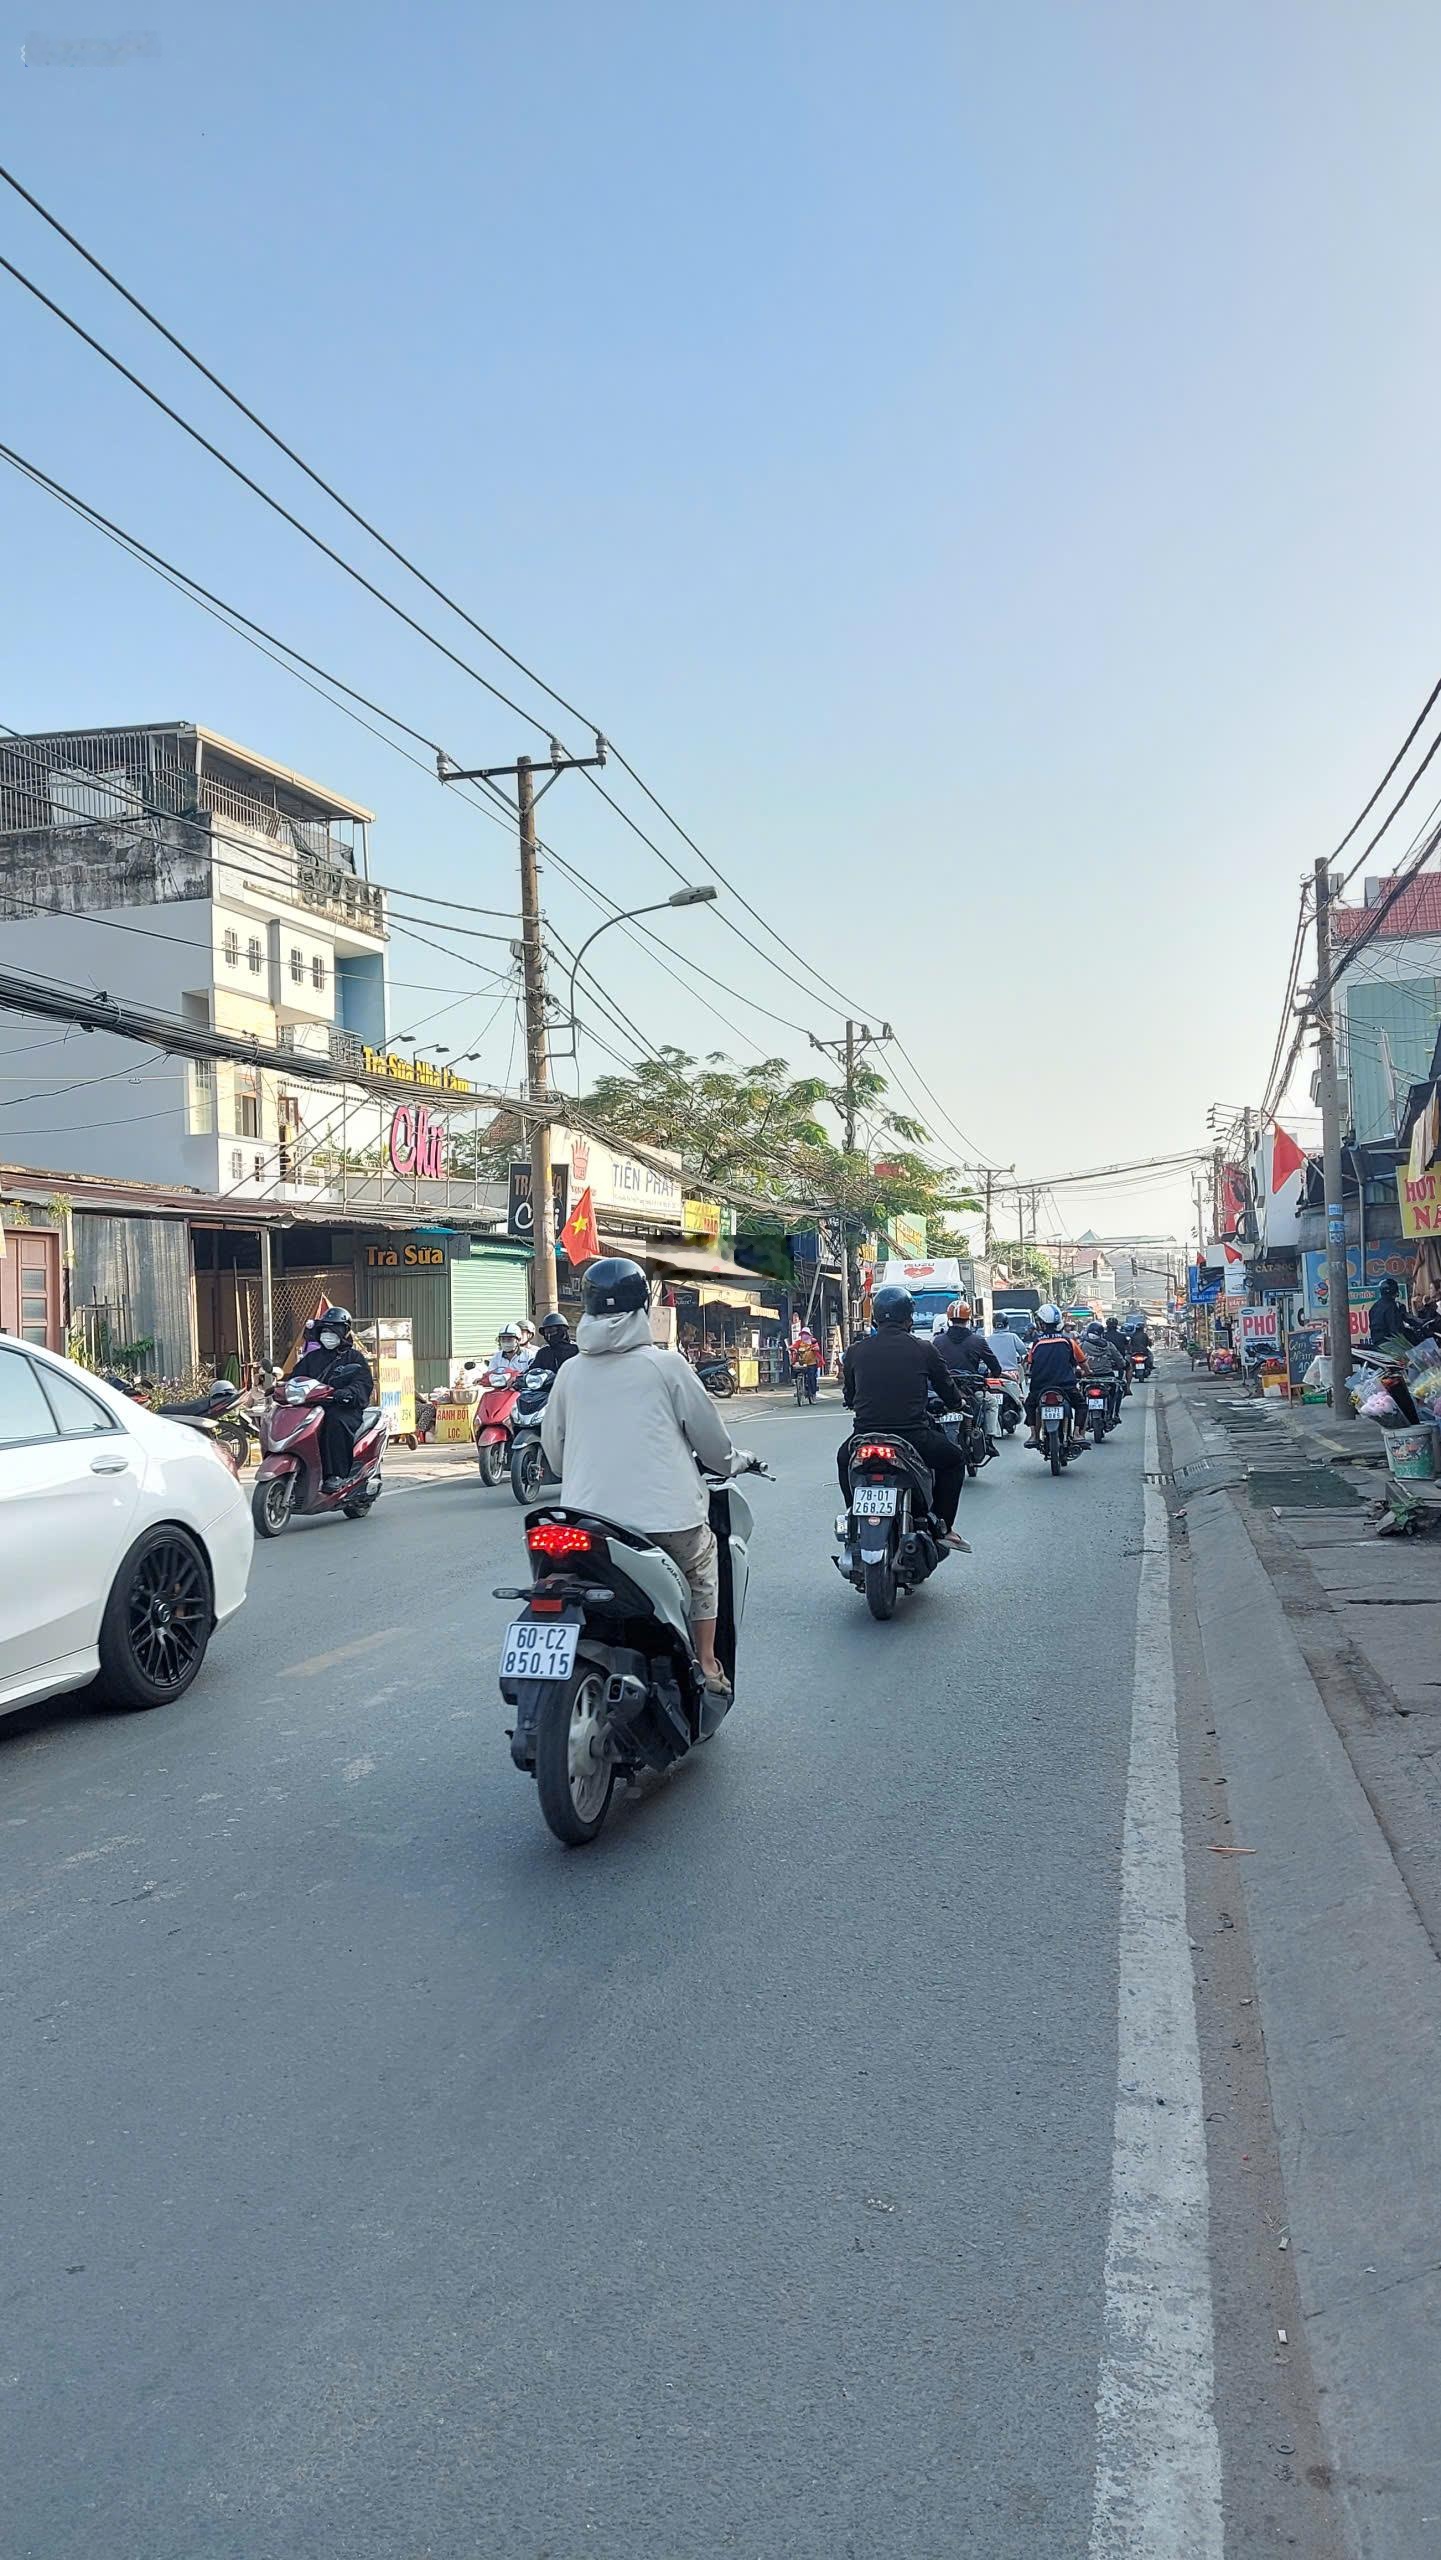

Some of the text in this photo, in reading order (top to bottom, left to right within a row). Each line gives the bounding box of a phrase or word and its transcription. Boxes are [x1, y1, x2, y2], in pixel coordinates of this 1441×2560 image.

[365, 1243, 444, 1266] Trà Sữa
[1242, 1308, 1277, 1337] PHỞ
[1349, 1304, 1369, 1335] BÚ
[860, 1489, 889, 1502] 78-01
[855, 1502, 893, 1514] 268.25
[517, 1627, 567, 1650] 60-C2
[505, 1651, 570, 1675] 850.15
